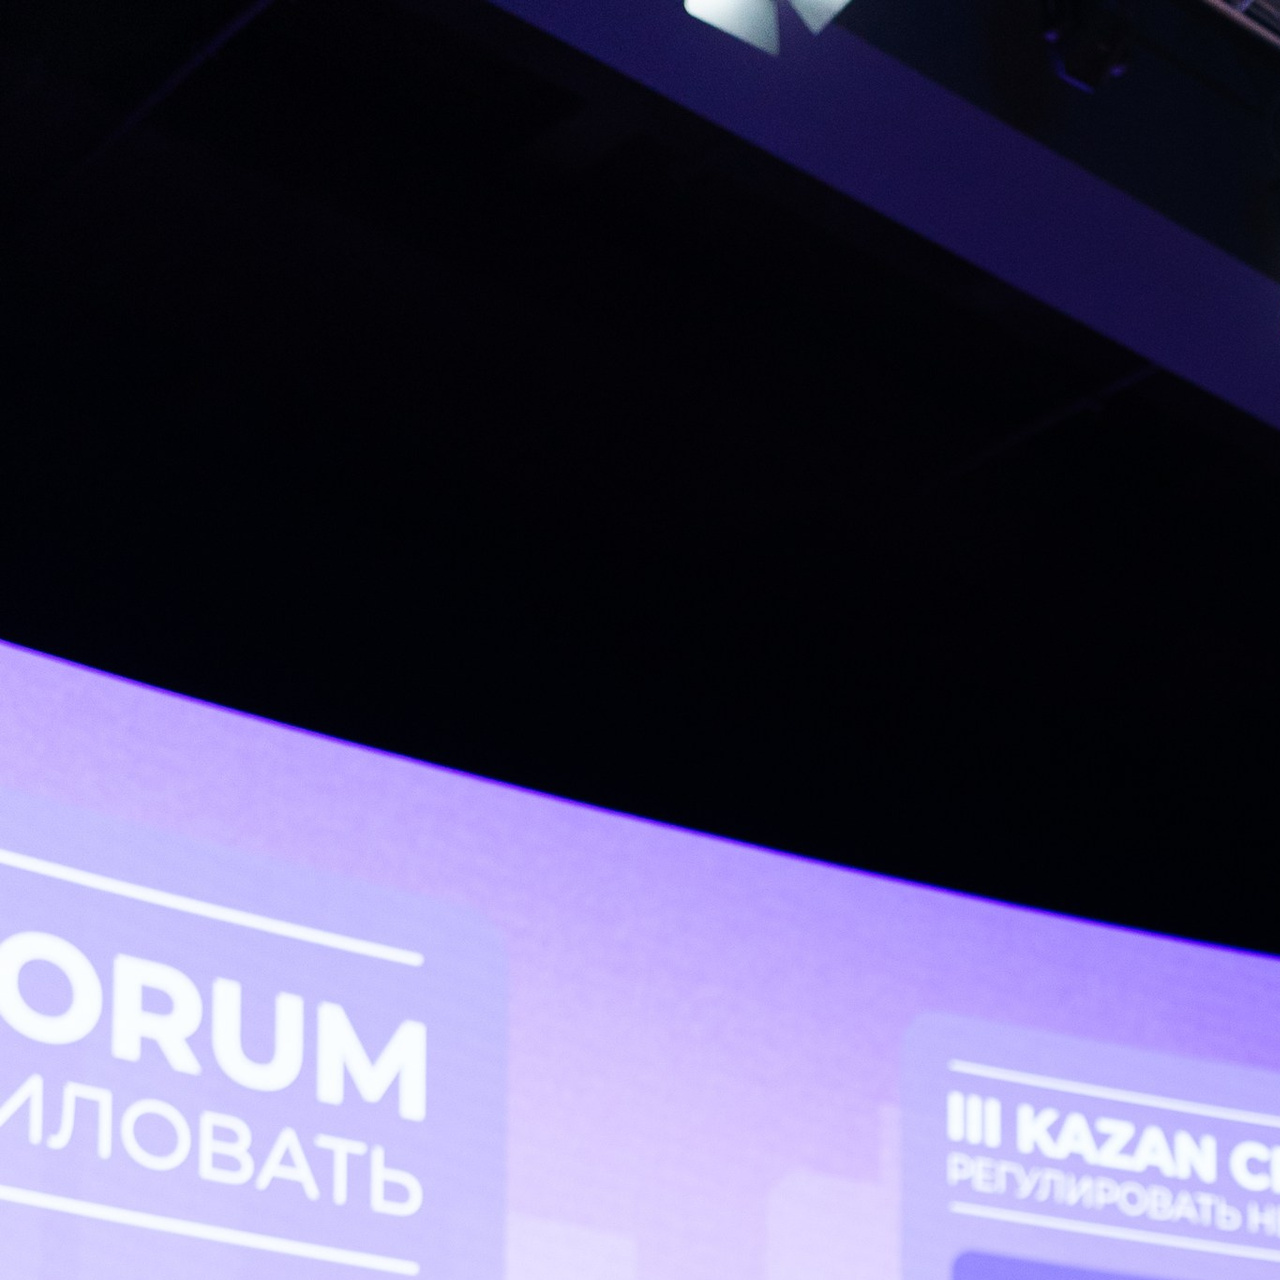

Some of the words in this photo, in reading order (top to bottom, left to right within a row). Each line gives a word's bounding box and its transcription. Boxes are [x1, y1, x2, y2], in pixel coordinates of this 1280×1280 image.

[0, 931, 427, 1122] ORUM
[946, 1090, 1001, 1149] III
[1016, 1103, 1217, 1184] KAZAN
[946, 1151, 1243, 1232] РЕГУЛИРОВАТЬ
